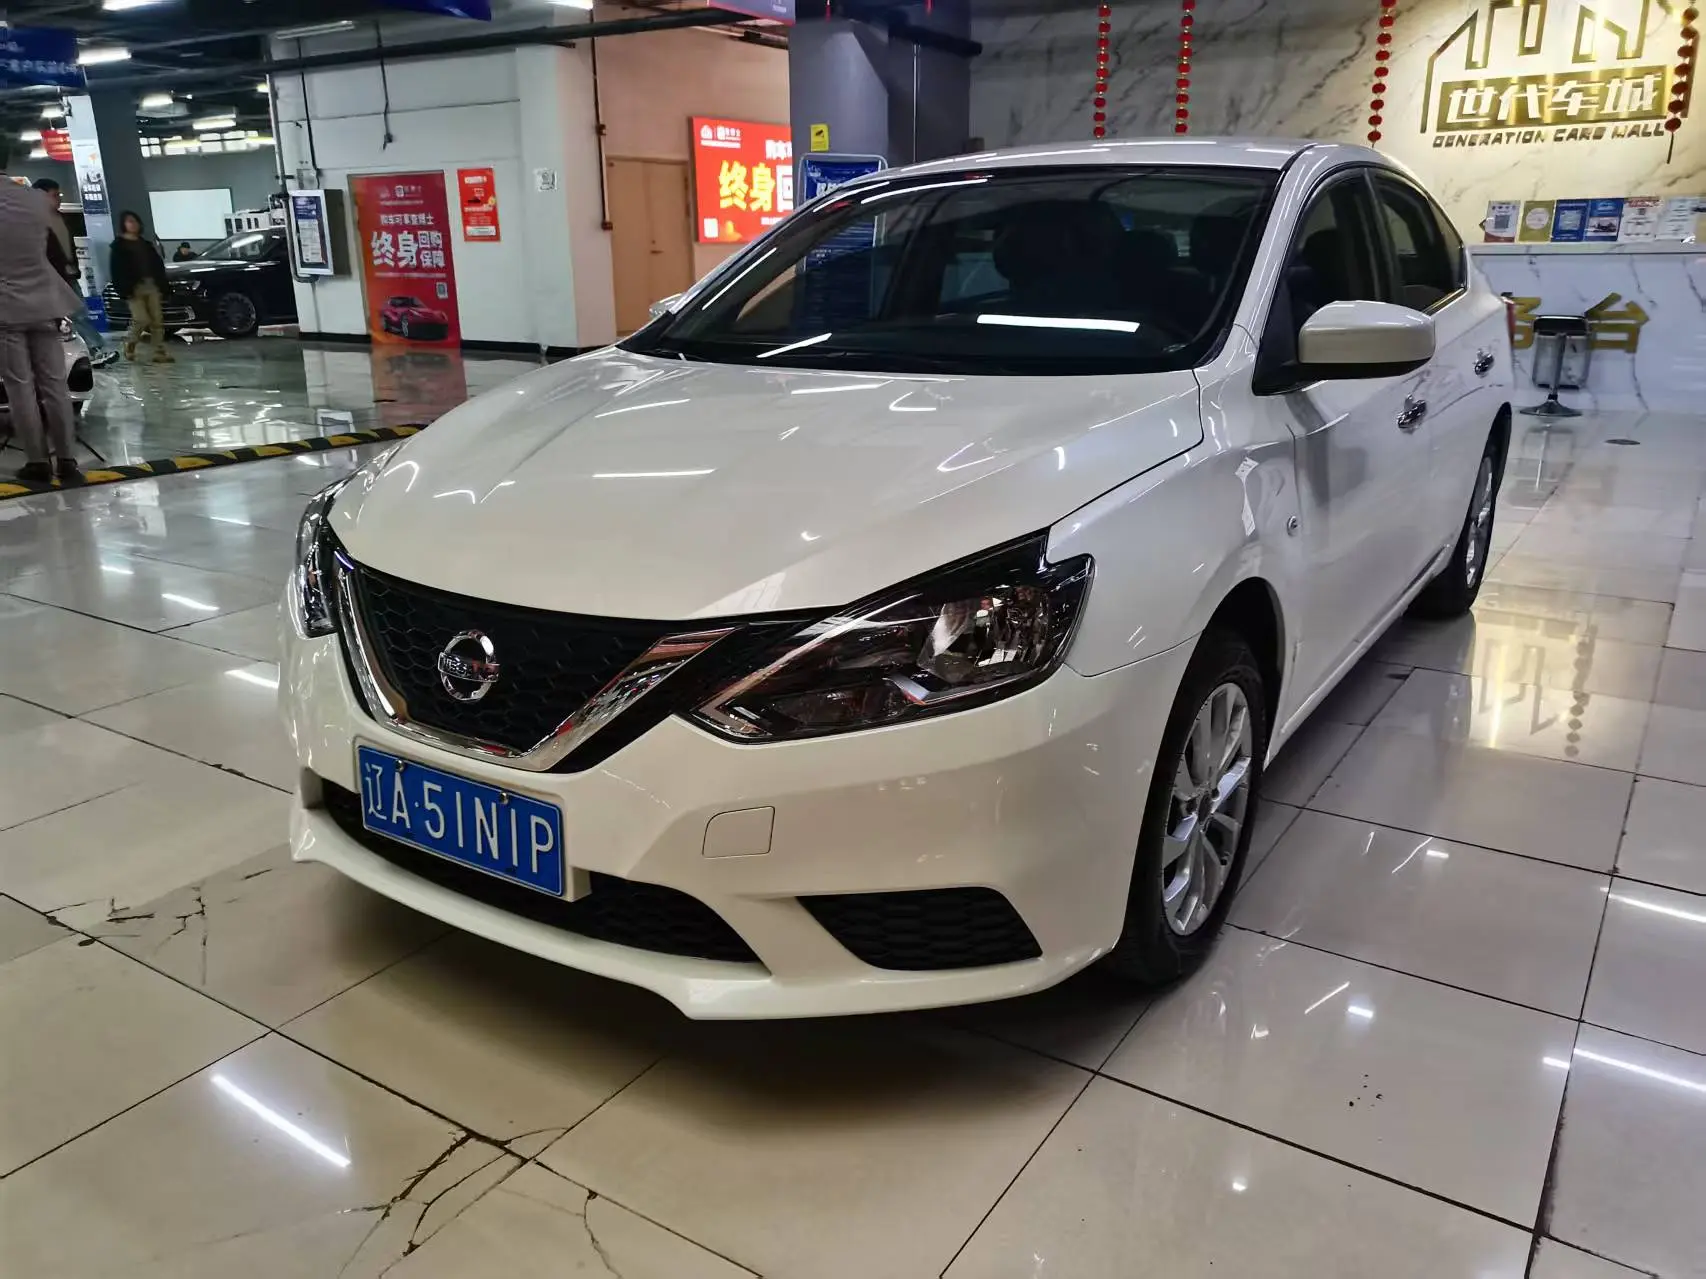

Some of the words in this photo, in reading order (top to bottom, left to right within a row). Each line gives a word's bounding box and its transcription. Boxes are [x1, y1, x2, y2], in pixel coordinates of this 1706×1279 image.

[1446, 73, 1662, 124] 世代车城
[1432, 130, 1546, 148] GENERATION
[1611, 122, 1665, 139] MALL
[371, 230, 418, 268] 终身
